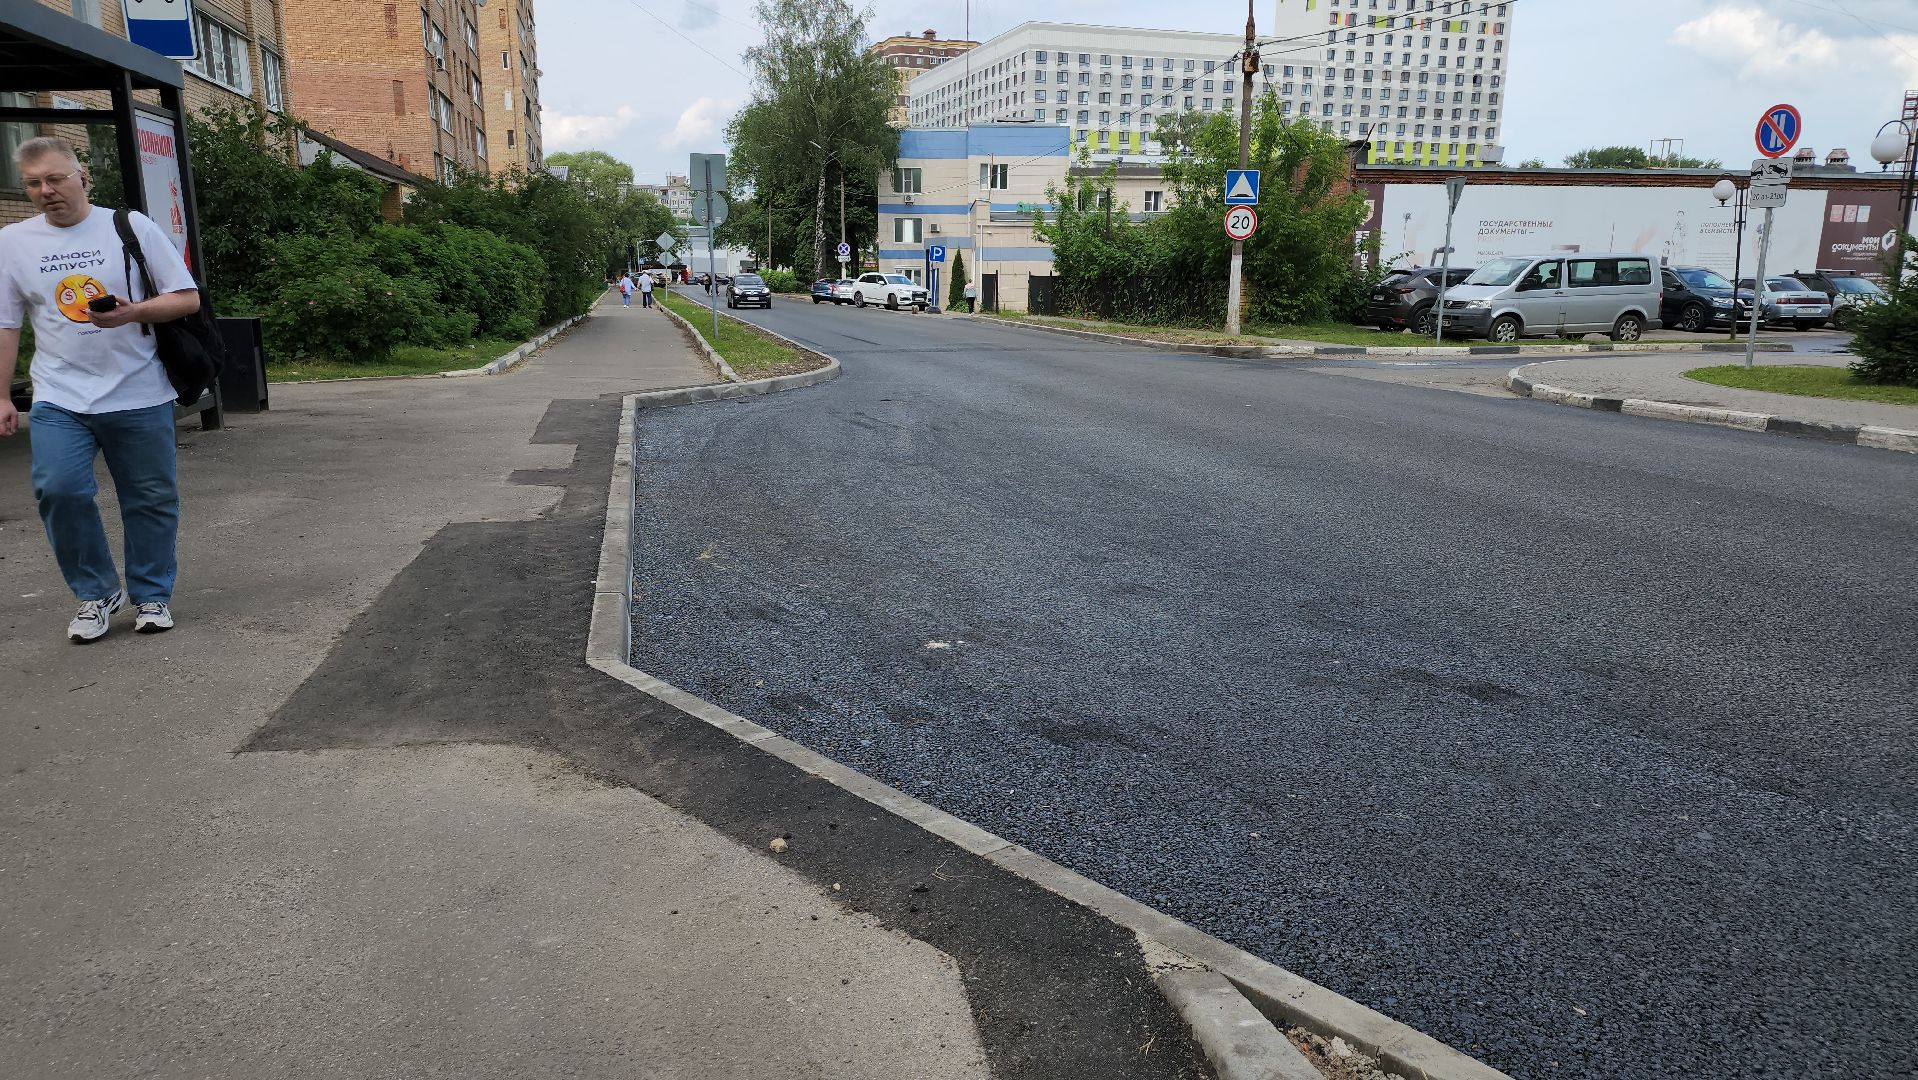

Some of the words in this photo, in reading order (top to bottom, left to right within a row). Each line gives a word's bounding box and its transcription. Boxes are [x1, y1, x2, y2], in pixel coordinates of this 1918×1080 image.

[1231, 215, 1250, 229] 20
[1479, 220, 1553, 228] ГОСУДАРСТВЕННЫЕ
[1478, 227, 1527, 235] ДОКУМЕНТЫ
[41, 249, 101, 263] ЗАНОСИ
[40, 258, 105, 274] КАПУСТУ
